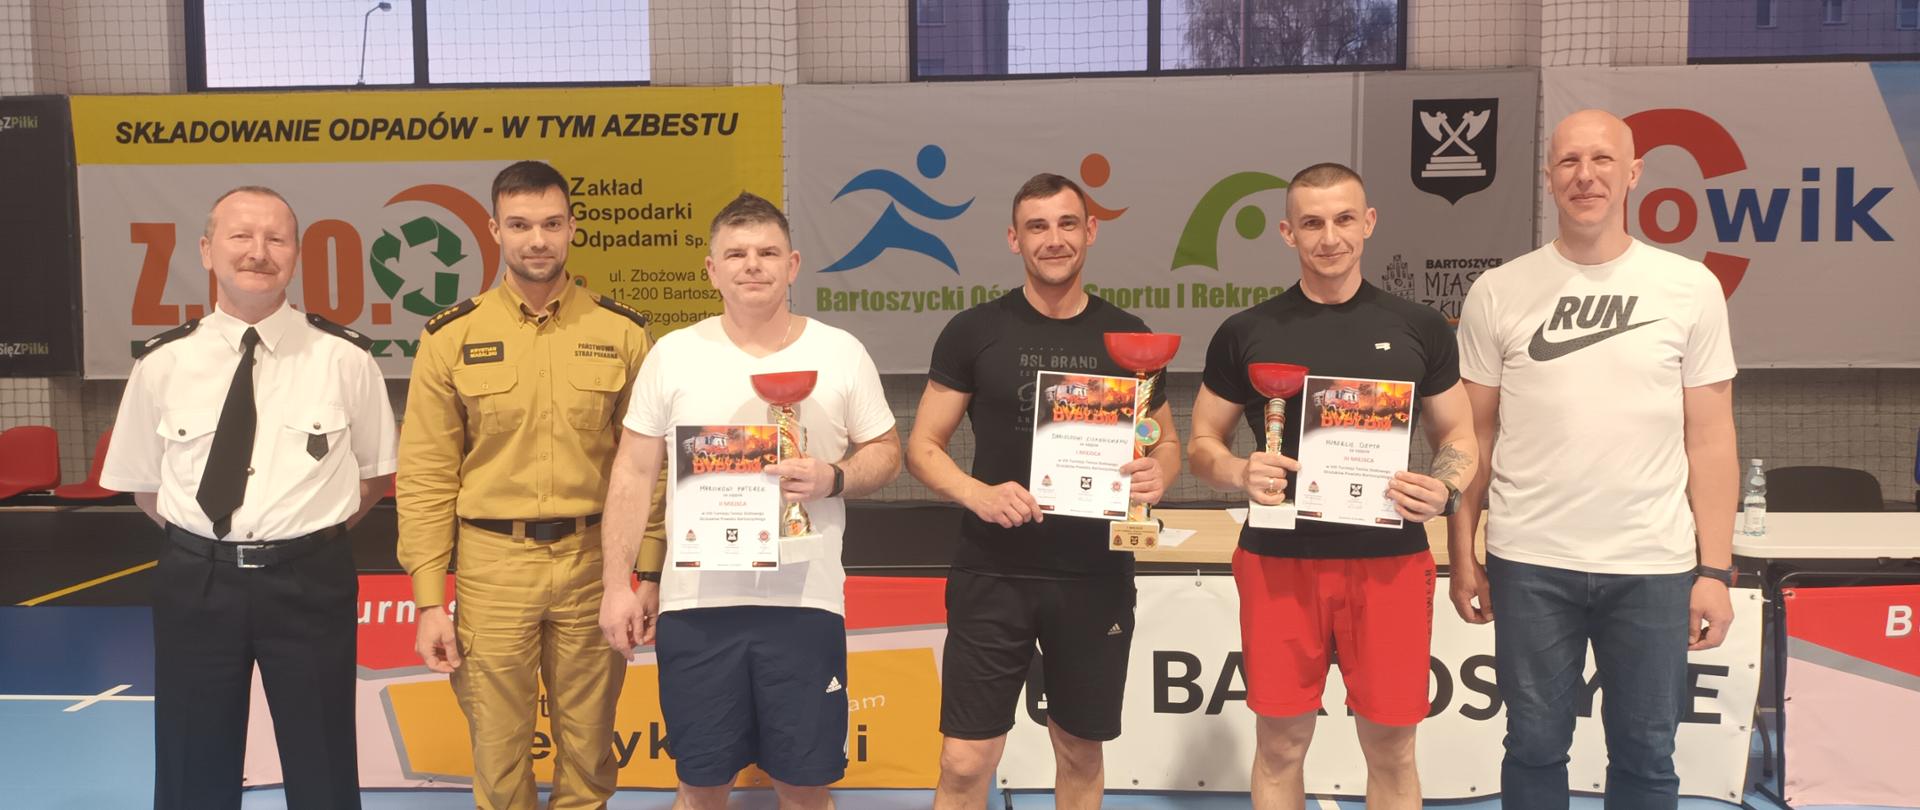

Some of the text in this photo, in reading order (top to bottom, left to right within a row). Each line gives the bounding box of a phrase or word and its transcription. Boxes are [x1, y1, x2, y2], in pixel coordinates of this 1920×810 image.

[115, 119, 321, 144] SKŁADOWANIE
[328, 112, 478, 142] ODPADÓW
[502, 117, 531, 139] W
[536, 115, 596, 138] TYM
[601, 112, 739, 137] AZBESTU
[570, 177, 643, 196] Zakład
[570, 202, 692, 224] Gospodarki
[571, 228, 678, 251] Odpadami
[1426, 258, 1502, 269] BARTOSZYCE
[609, 270, 625, 282] ul.
[631, 269, 696, 282] Zbożowa
[610, 288, 658, 301] 11-200
[816, 286, 964, 313] Bartoszycki
[1548, 294, 1639, 331] RUN
[1051, 356, 1098, 370] BRAND
